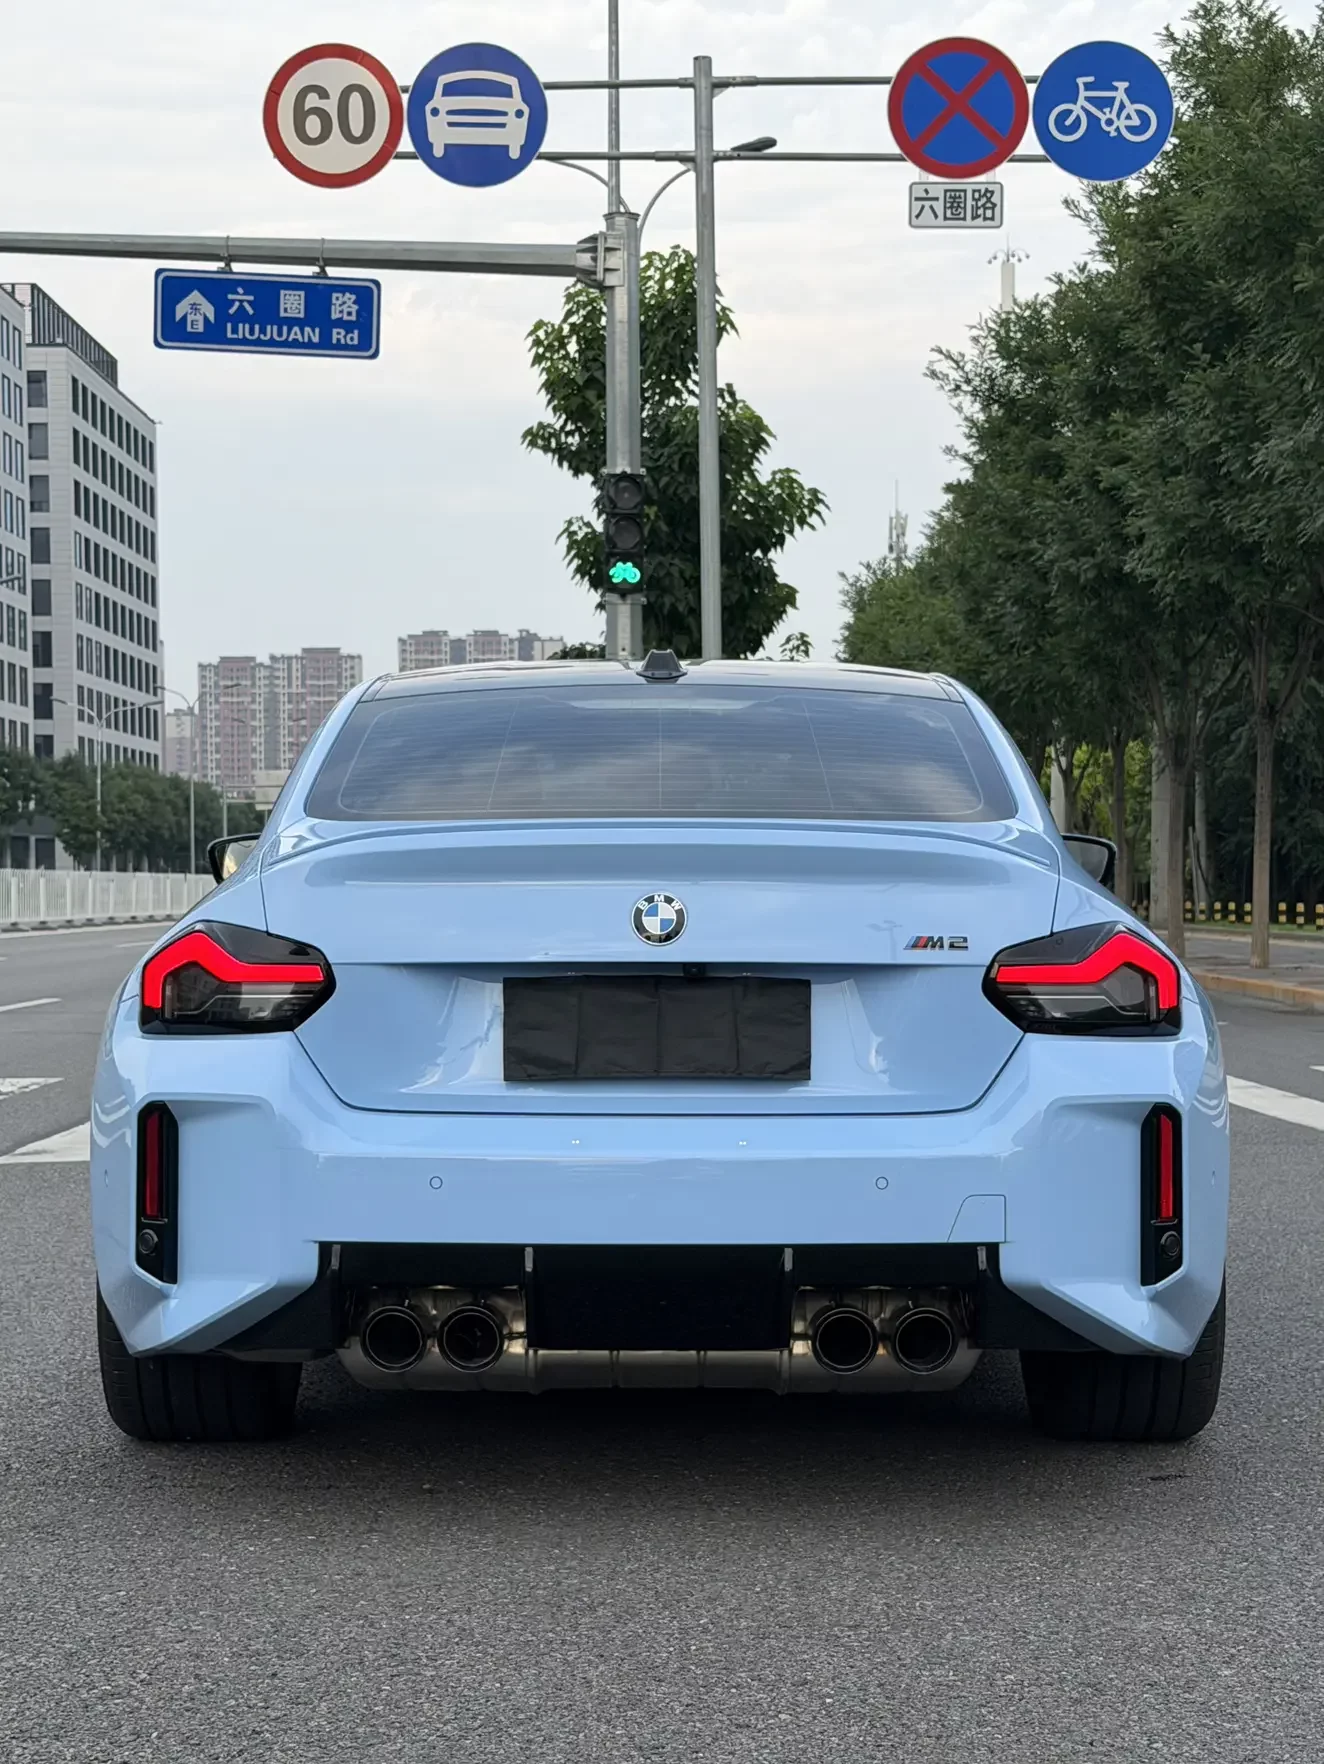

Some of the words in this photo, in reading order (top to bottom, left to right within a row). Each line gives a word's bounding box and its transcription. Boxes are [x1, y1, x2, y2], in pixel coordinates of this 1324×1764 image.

[293, 83, 376, 146] 60
[913, 187, 998, 222] 六圈路
[188, 302, 202, 316] 东
[227, 287, 359, 321] 六圈路
[190, 319, 200, 330] E
[226, 322, 320, 344] LIUJUAN
[332, 328, 359, 345] Rd
[637, 894, 682, 911] BMW
